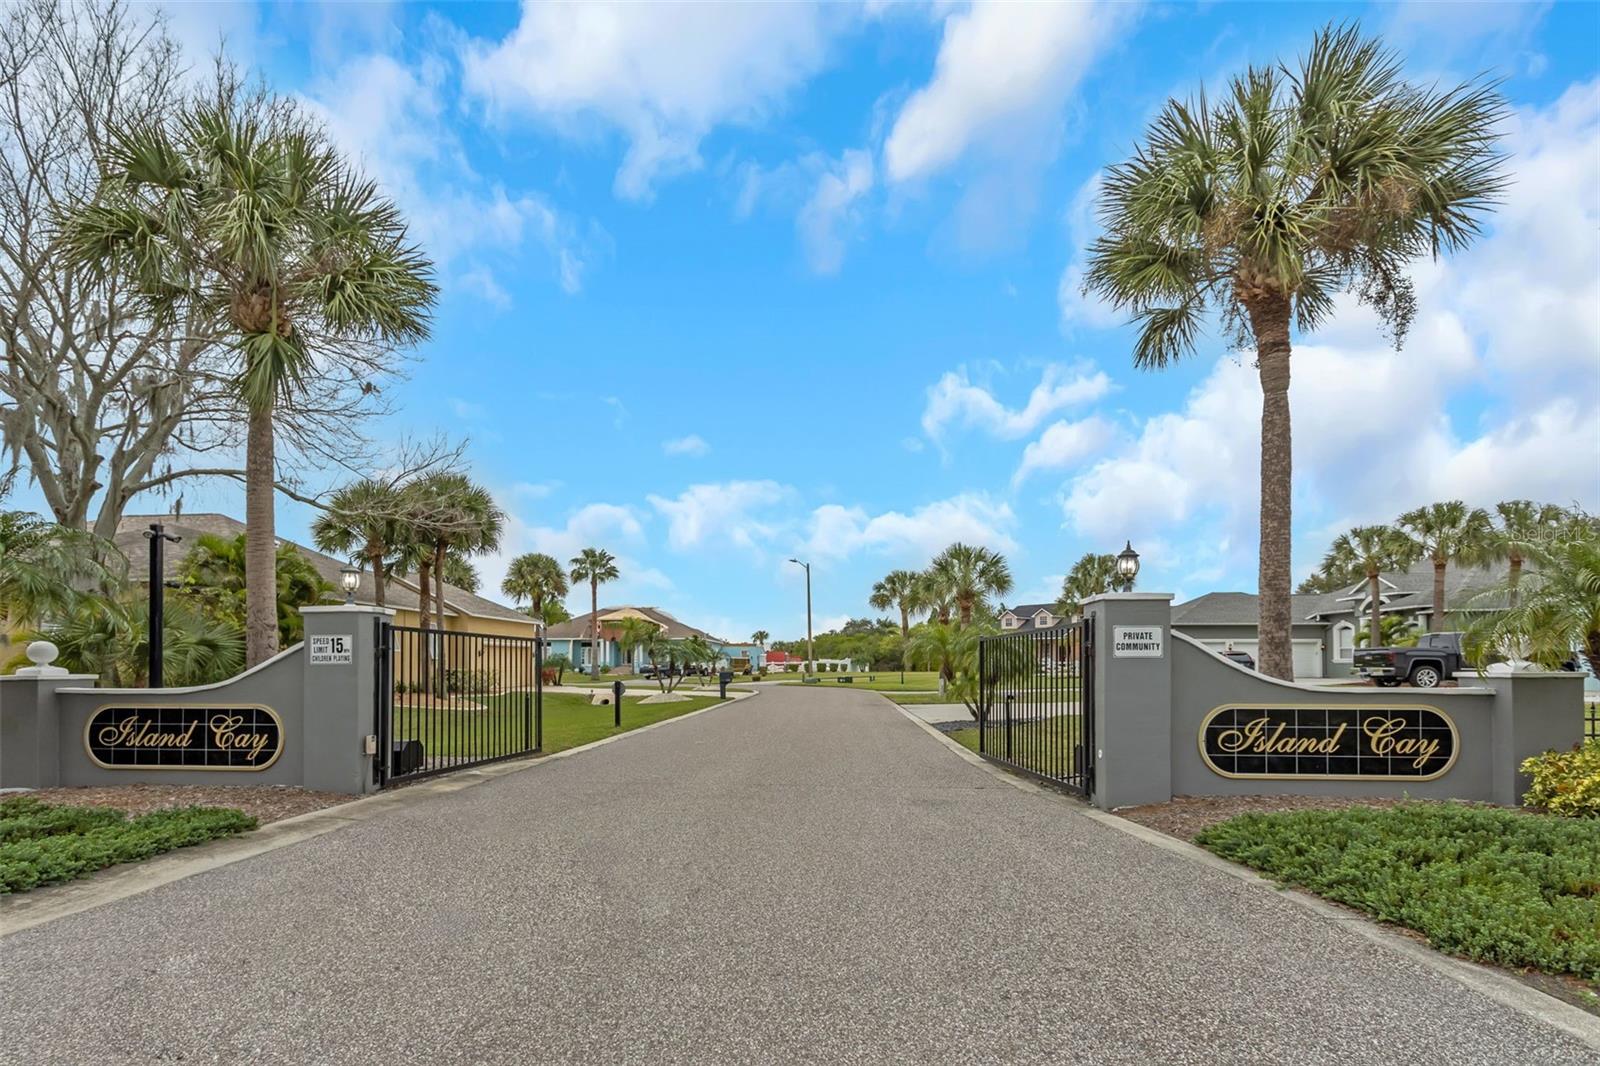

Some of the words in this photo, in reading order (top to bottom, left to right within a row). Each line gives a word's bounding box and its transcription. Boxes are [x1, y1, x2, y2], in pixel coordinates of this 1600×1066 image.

[1123, 632, 1153, 640] PRIVATE
[313, 646, 328, 654] LIMIT
[330, 638, 343, 653] 15
[1116, 643, 1161, 651] COMMUNITY
[98, 715, 200, 748] Island
[210, 714, 269, 760] Cay
[1217, 717, 1348, 754] Island
[1363, 716, 1440, 768] Cay
